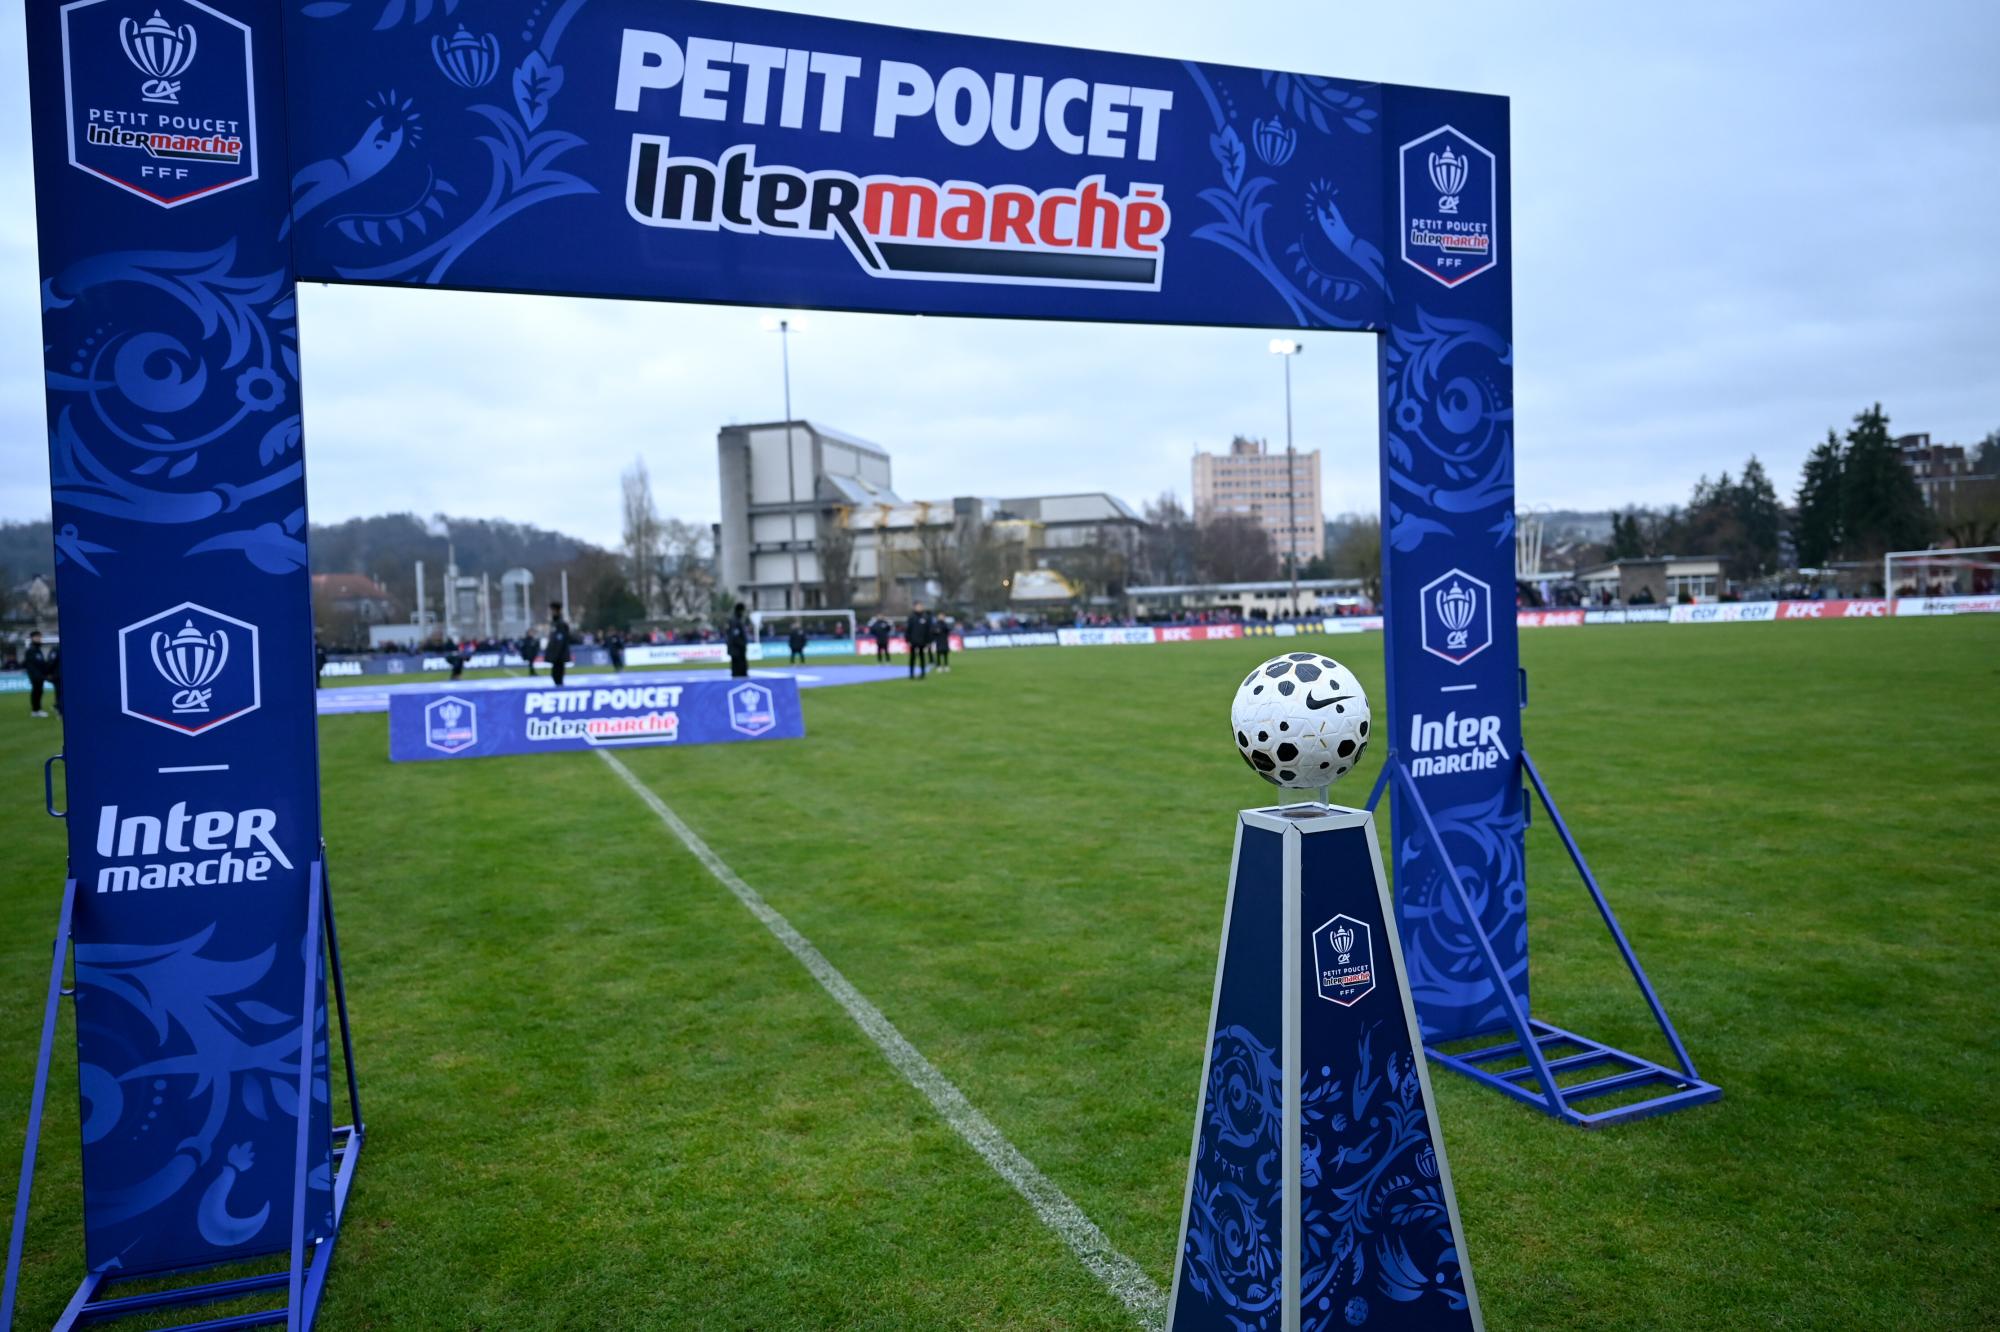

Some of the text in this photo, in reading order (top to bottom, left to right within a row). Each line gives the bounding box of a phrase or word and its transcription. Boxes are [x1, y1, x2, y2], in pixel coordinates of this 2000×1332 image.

[615, 28, 1174, 161] PETIT POUCET
[89, 108, 239, 133] PETIT POUCET
[1412, 218, 1488, 233] PETIT POUCET
[1784, 600, 1888, 617] KFC KFC
[525, 686, 683, 714] PETIT POUCET
[1410, 711, 1510, 760] Inter
[96, 801, 294, 869] Inter
[1323, 965, 1369, 977] PETIT POUCET
